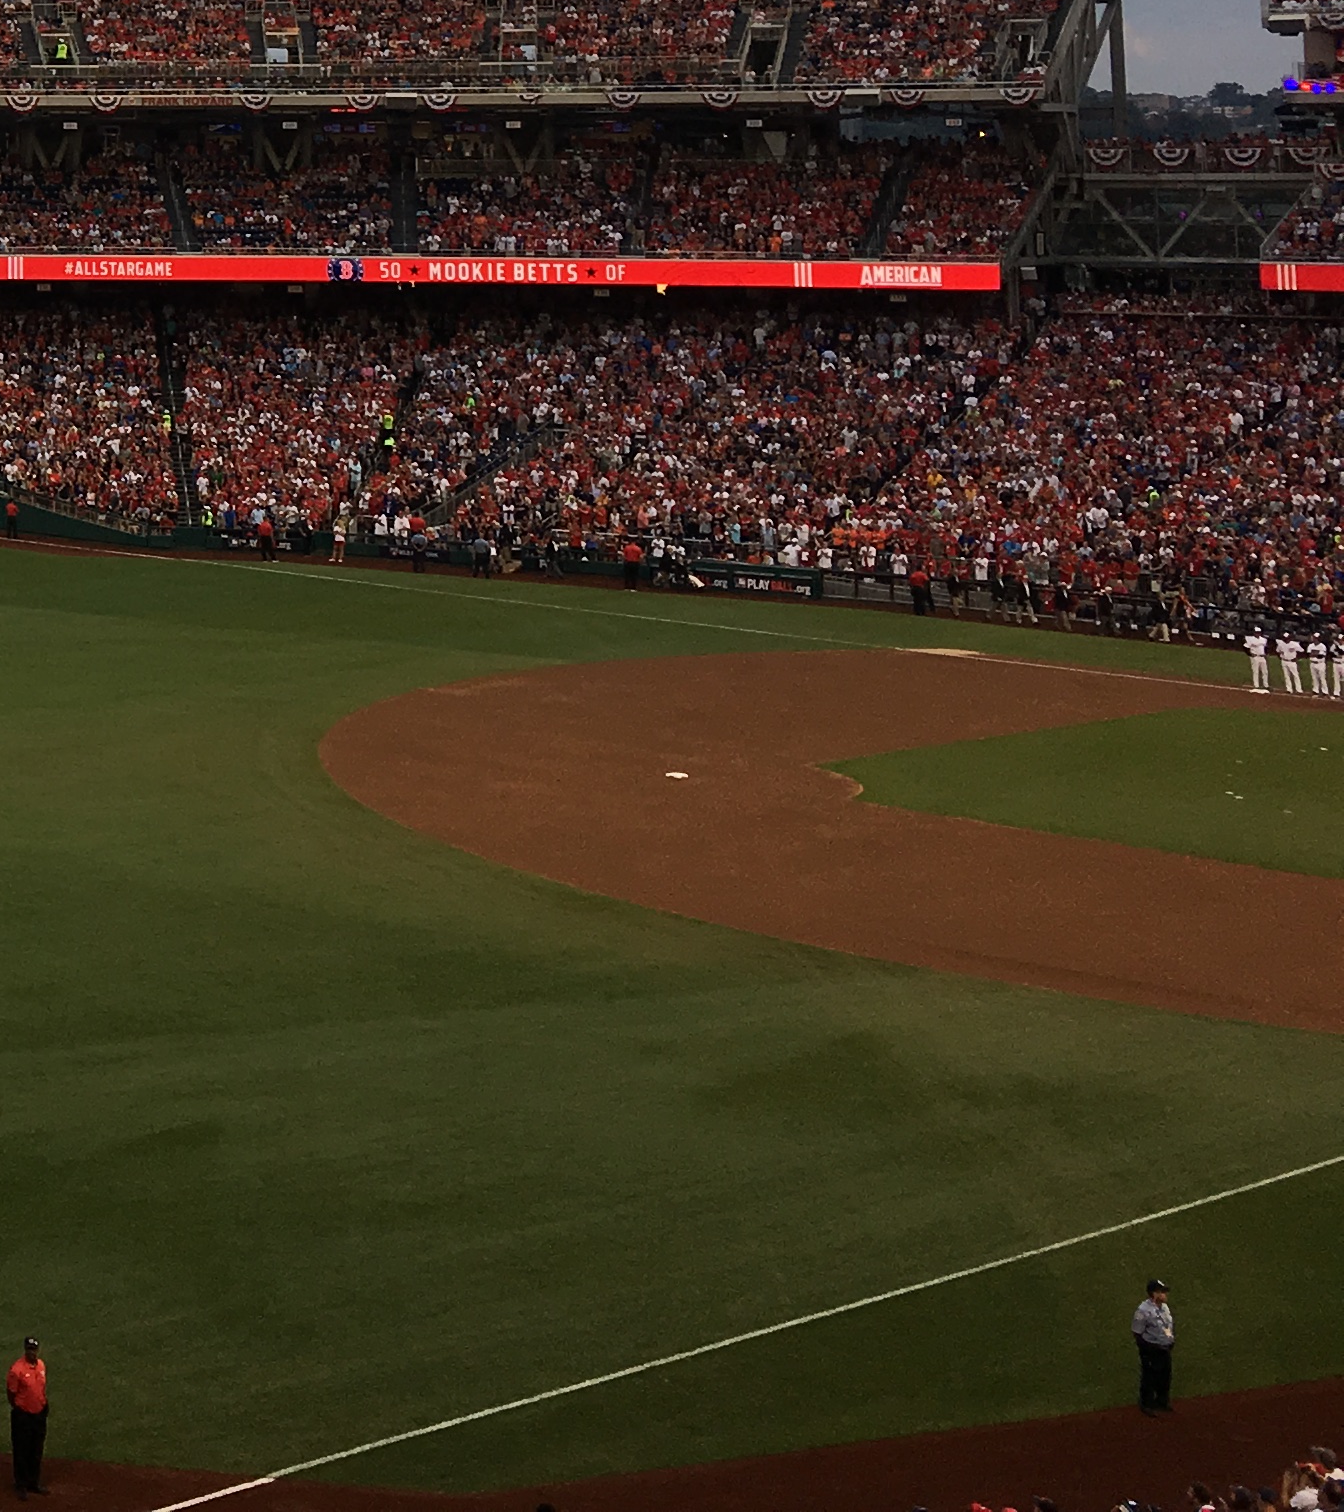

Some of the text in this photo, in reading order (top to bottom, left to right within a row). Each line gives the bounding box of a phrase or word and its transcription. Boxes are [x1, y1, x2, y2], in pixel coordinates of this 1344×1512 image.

[142, 97, 233, 105] FRANK HOWARD
[65, 261, 173, 277] #ALLSTARGAME
[380, 262, 401, 279] 50
[429, 262, 506, 281] MOOKIE
[513, 263, 578, 282] BETTS
[605, 264, 626, 281] OF
[860, 265, 942, 286] AMERICAN
